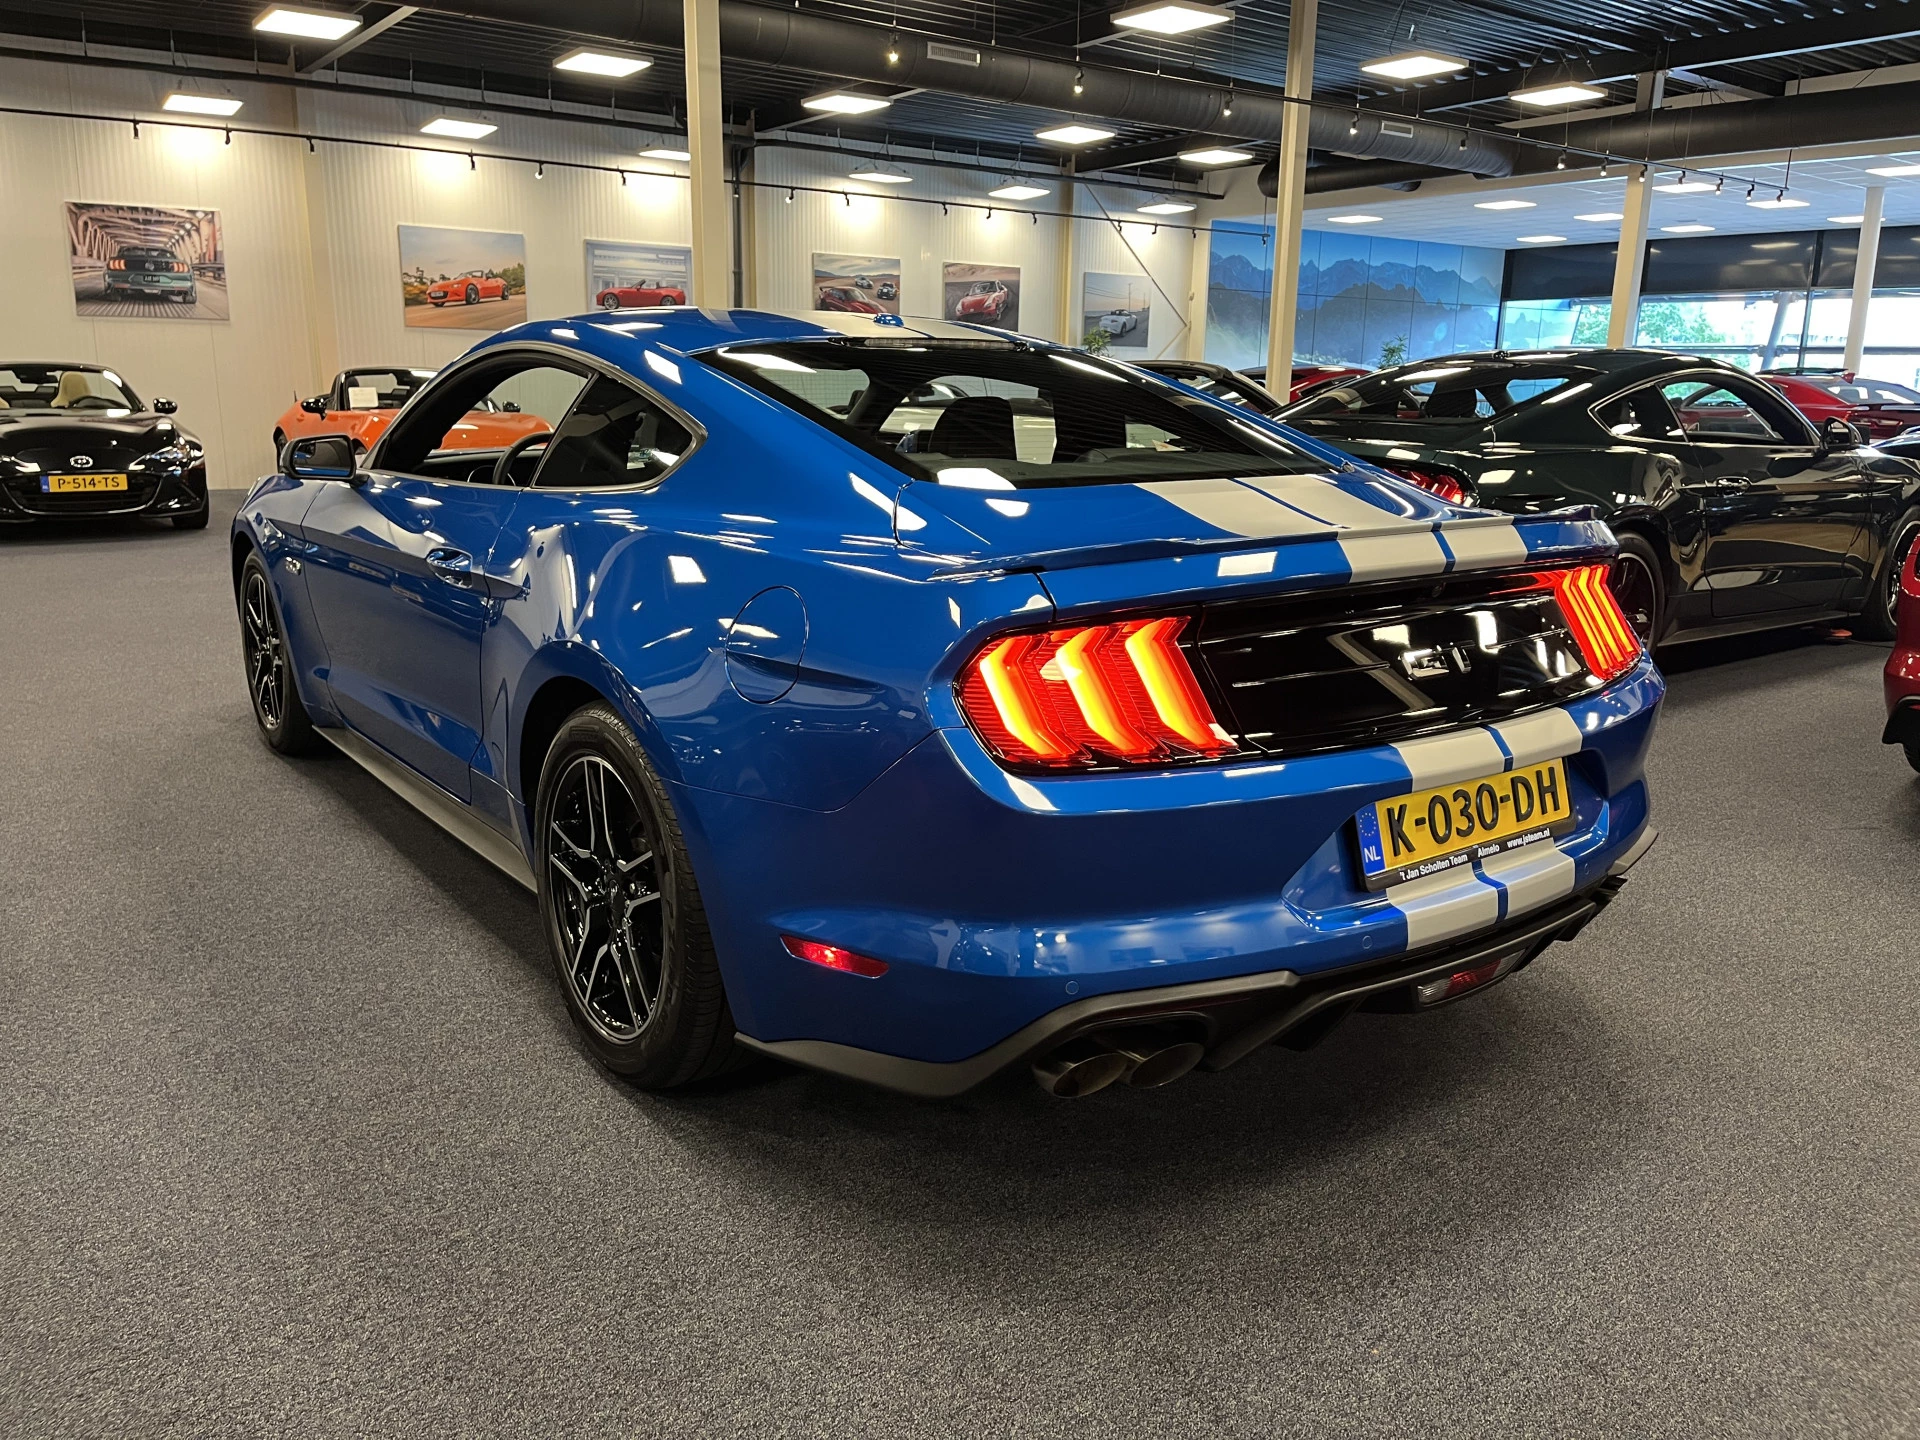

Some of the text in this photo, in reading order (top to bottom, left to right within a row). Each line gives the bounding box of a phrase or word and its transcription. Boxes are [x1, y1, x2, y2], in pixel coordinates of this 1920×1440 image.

[57, 476, 120, 489] P-514-TS
[1386, 767, 1560, 857] K-030-DH
[1364, 846, 1381, 863] NL
[1406, 868, 1420, 880] Jan
[1419, 858, 1450, 875] Scholten
[1450, 853, 1468, 867] Team
[1477, 844, 1500, 858] Almelo
[1506, 828, 1550, 849] www.jsteam.nl
